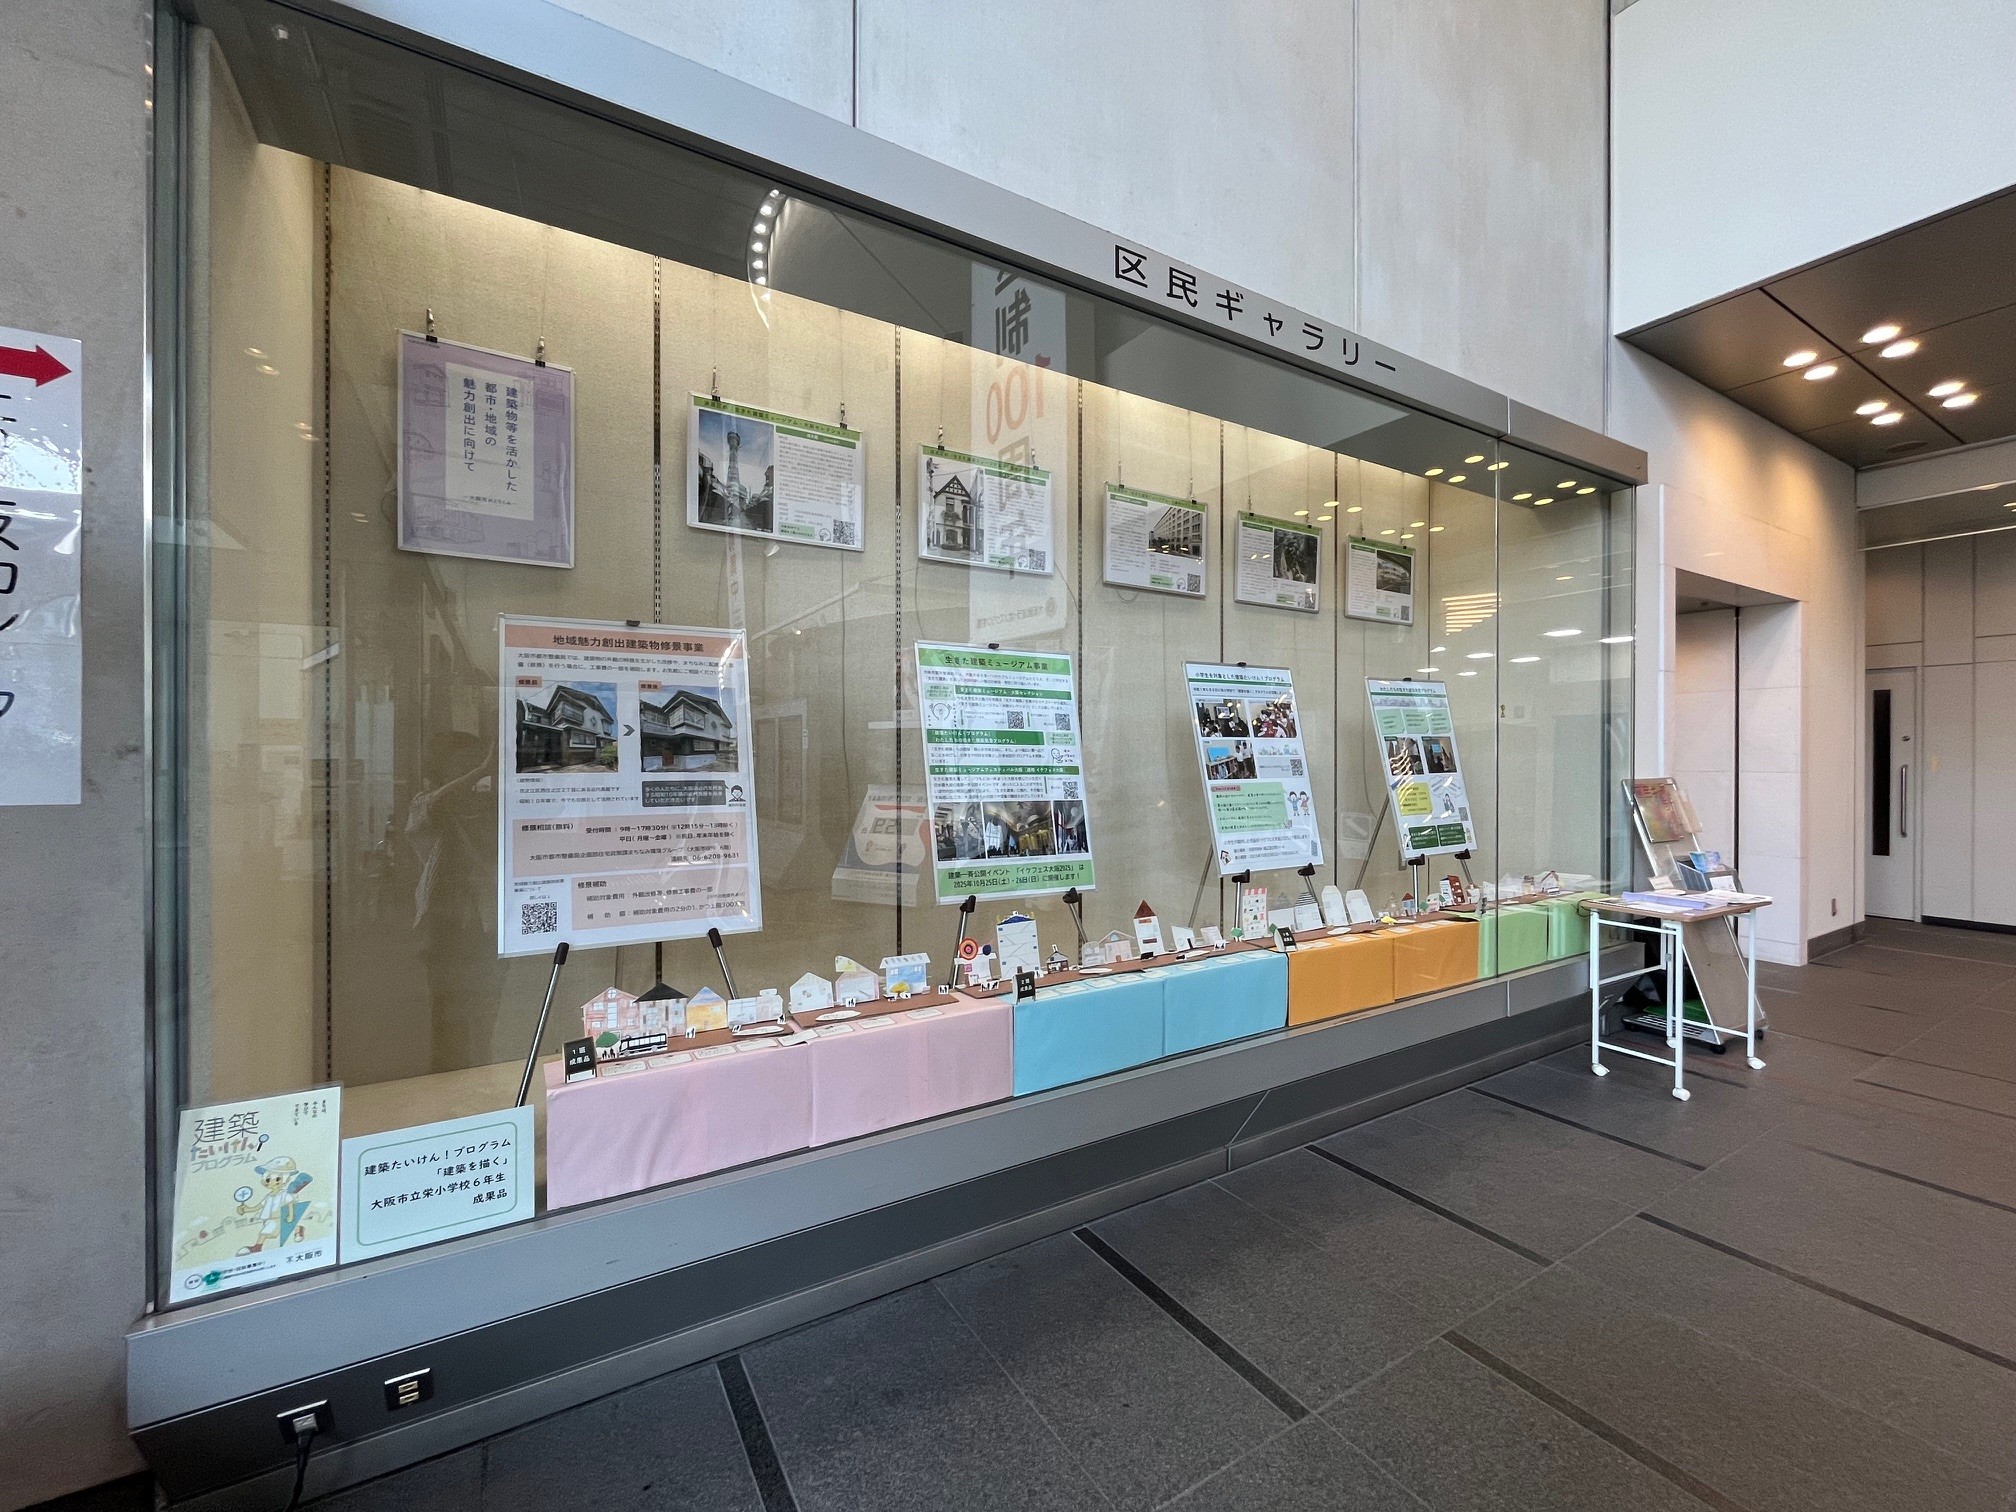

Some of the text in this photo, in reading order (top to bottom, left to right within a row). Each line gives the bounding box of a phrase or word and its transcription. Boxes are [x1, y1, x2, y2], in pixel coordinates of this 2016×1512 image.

[1114, 244, 1396, 372] 区民ギャラリー
[485, 382, 497, 446] 都市・地域の
[463, 378, 476, 472] 魅力創出に向けて
[506, 386, 519, 492] 建築物等を活かした
[553, 635, 704, 653] 地域魅力創出建築物修景事業
[945, 656, 1049, 671] 生きた建築ミュージアム事業
[692, 852, 738, 861] 06-6208-9631
[578, 881, 607, 890] 修景補助
[193, 1111, 259, 1146] 建築
[191, 1153, 258, 1174] プログラム
[364, 1138, 511, 1176] 建築たいけん！プログラム
[436, 1157, 509, 1178] 「建築を描く」
[371, 1172, 506, 1211] 大阪市立栄小学校6年生
[473, 1188, 508, 1205] 成果品
[295, 1250, 322, 1262] 大阪市
